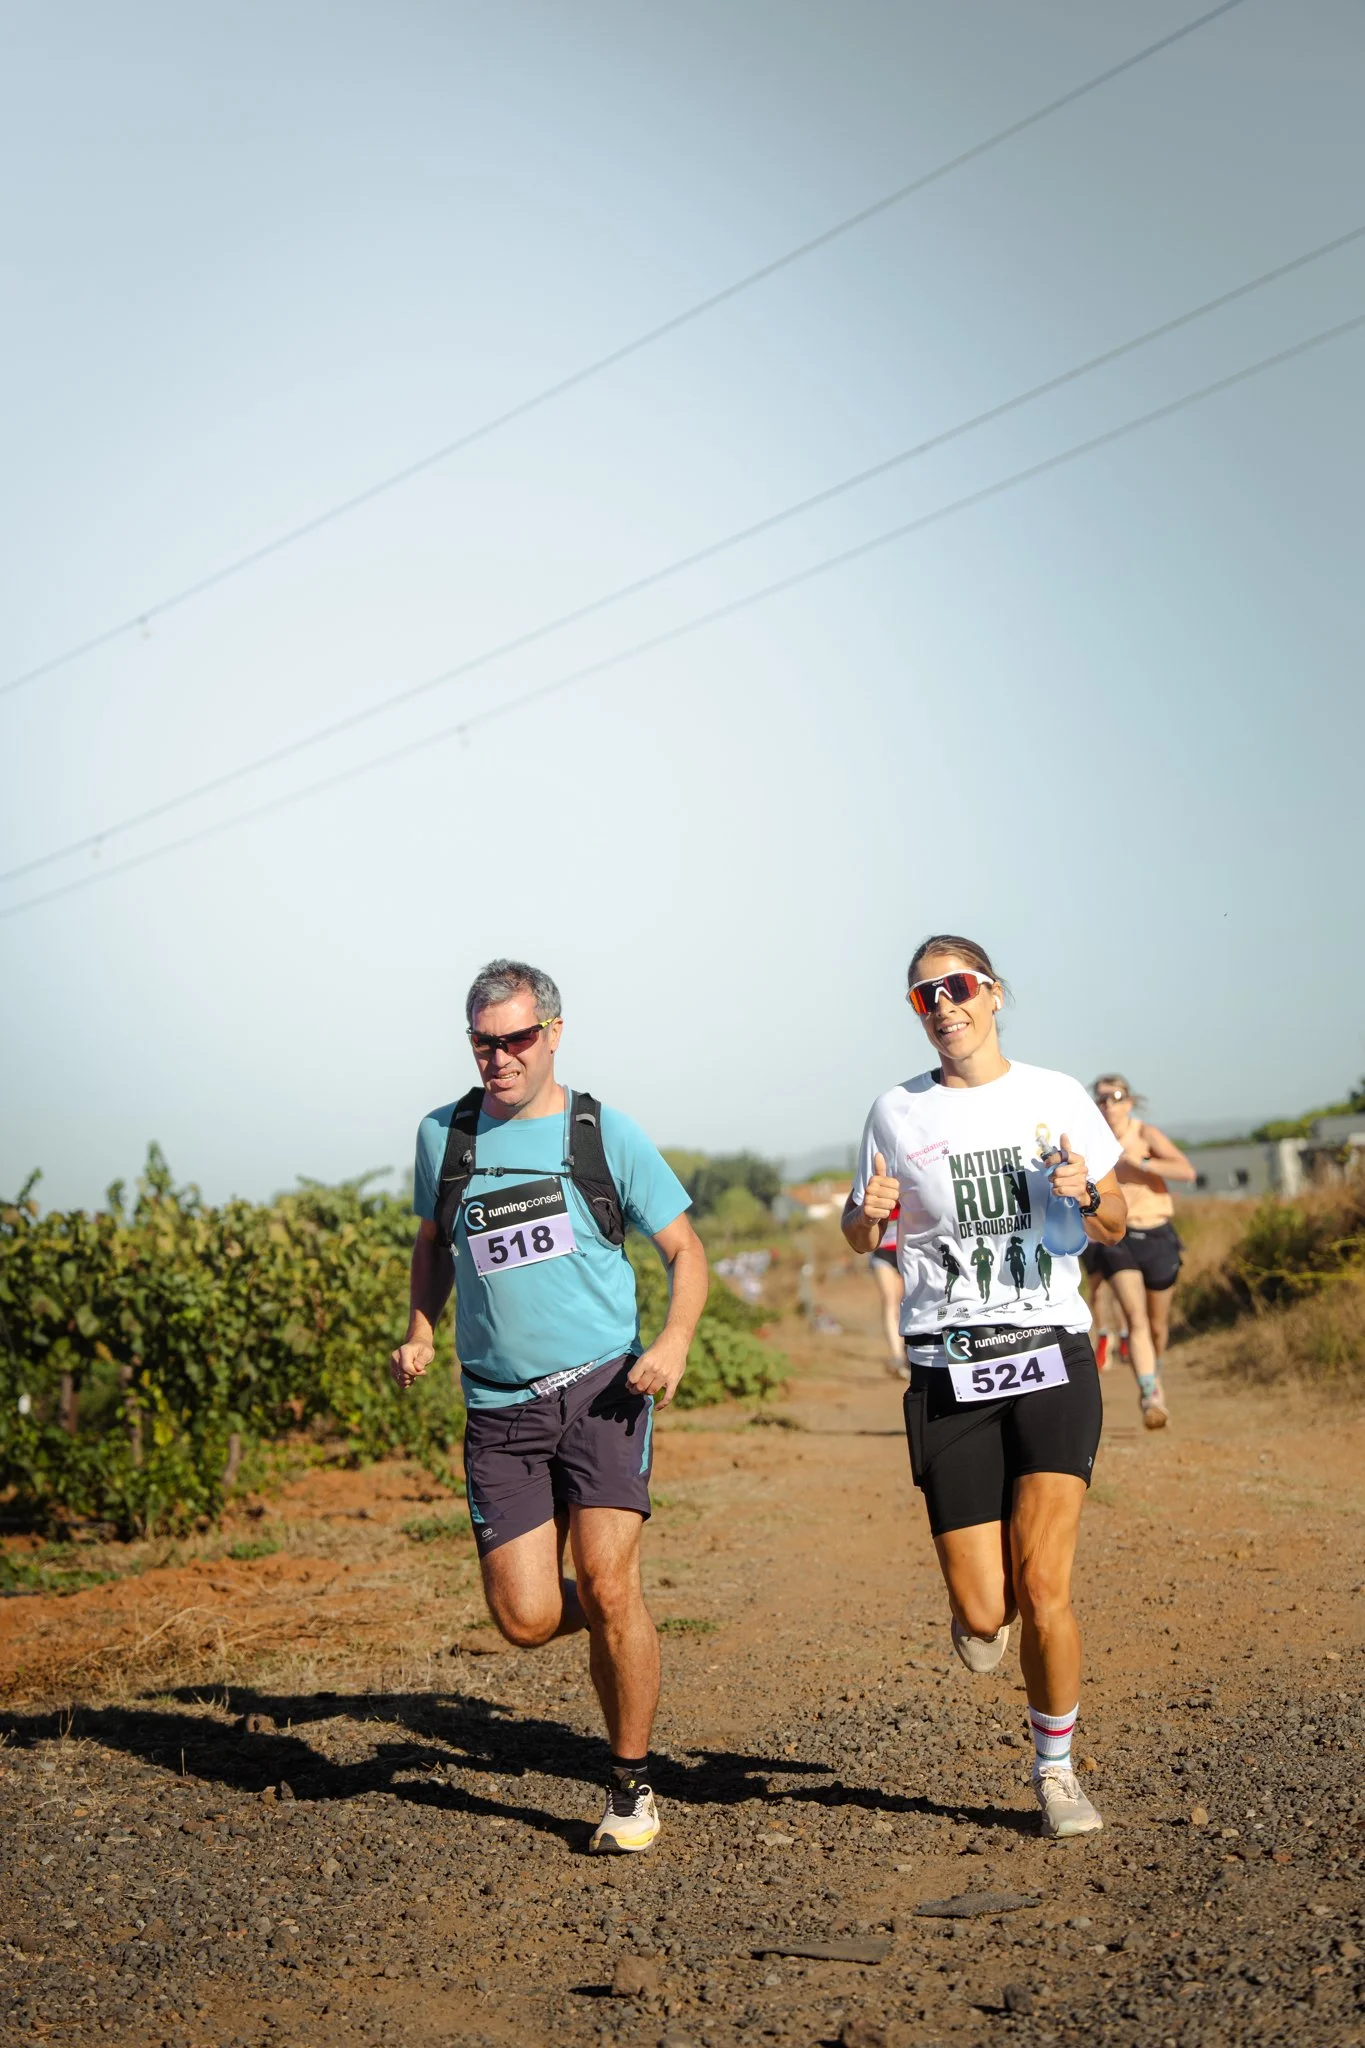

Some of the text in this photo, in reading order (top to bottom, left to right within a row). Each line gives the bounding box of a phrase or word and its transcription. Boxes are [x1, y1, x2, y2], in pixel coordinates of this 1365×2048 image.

[906, 1140, 949, 1161] Association
[948, 1146, 1025, 1179] NATURE
[488, 1191, 562, 1218] runningconseil
[953, 1171, 1031, 1222] RUN
[959, 1214, 1031, 1239] DE BOURBAKI
[487, 1225, 555, 1264] 518
[971, 1356, 1046, 1394] 524
